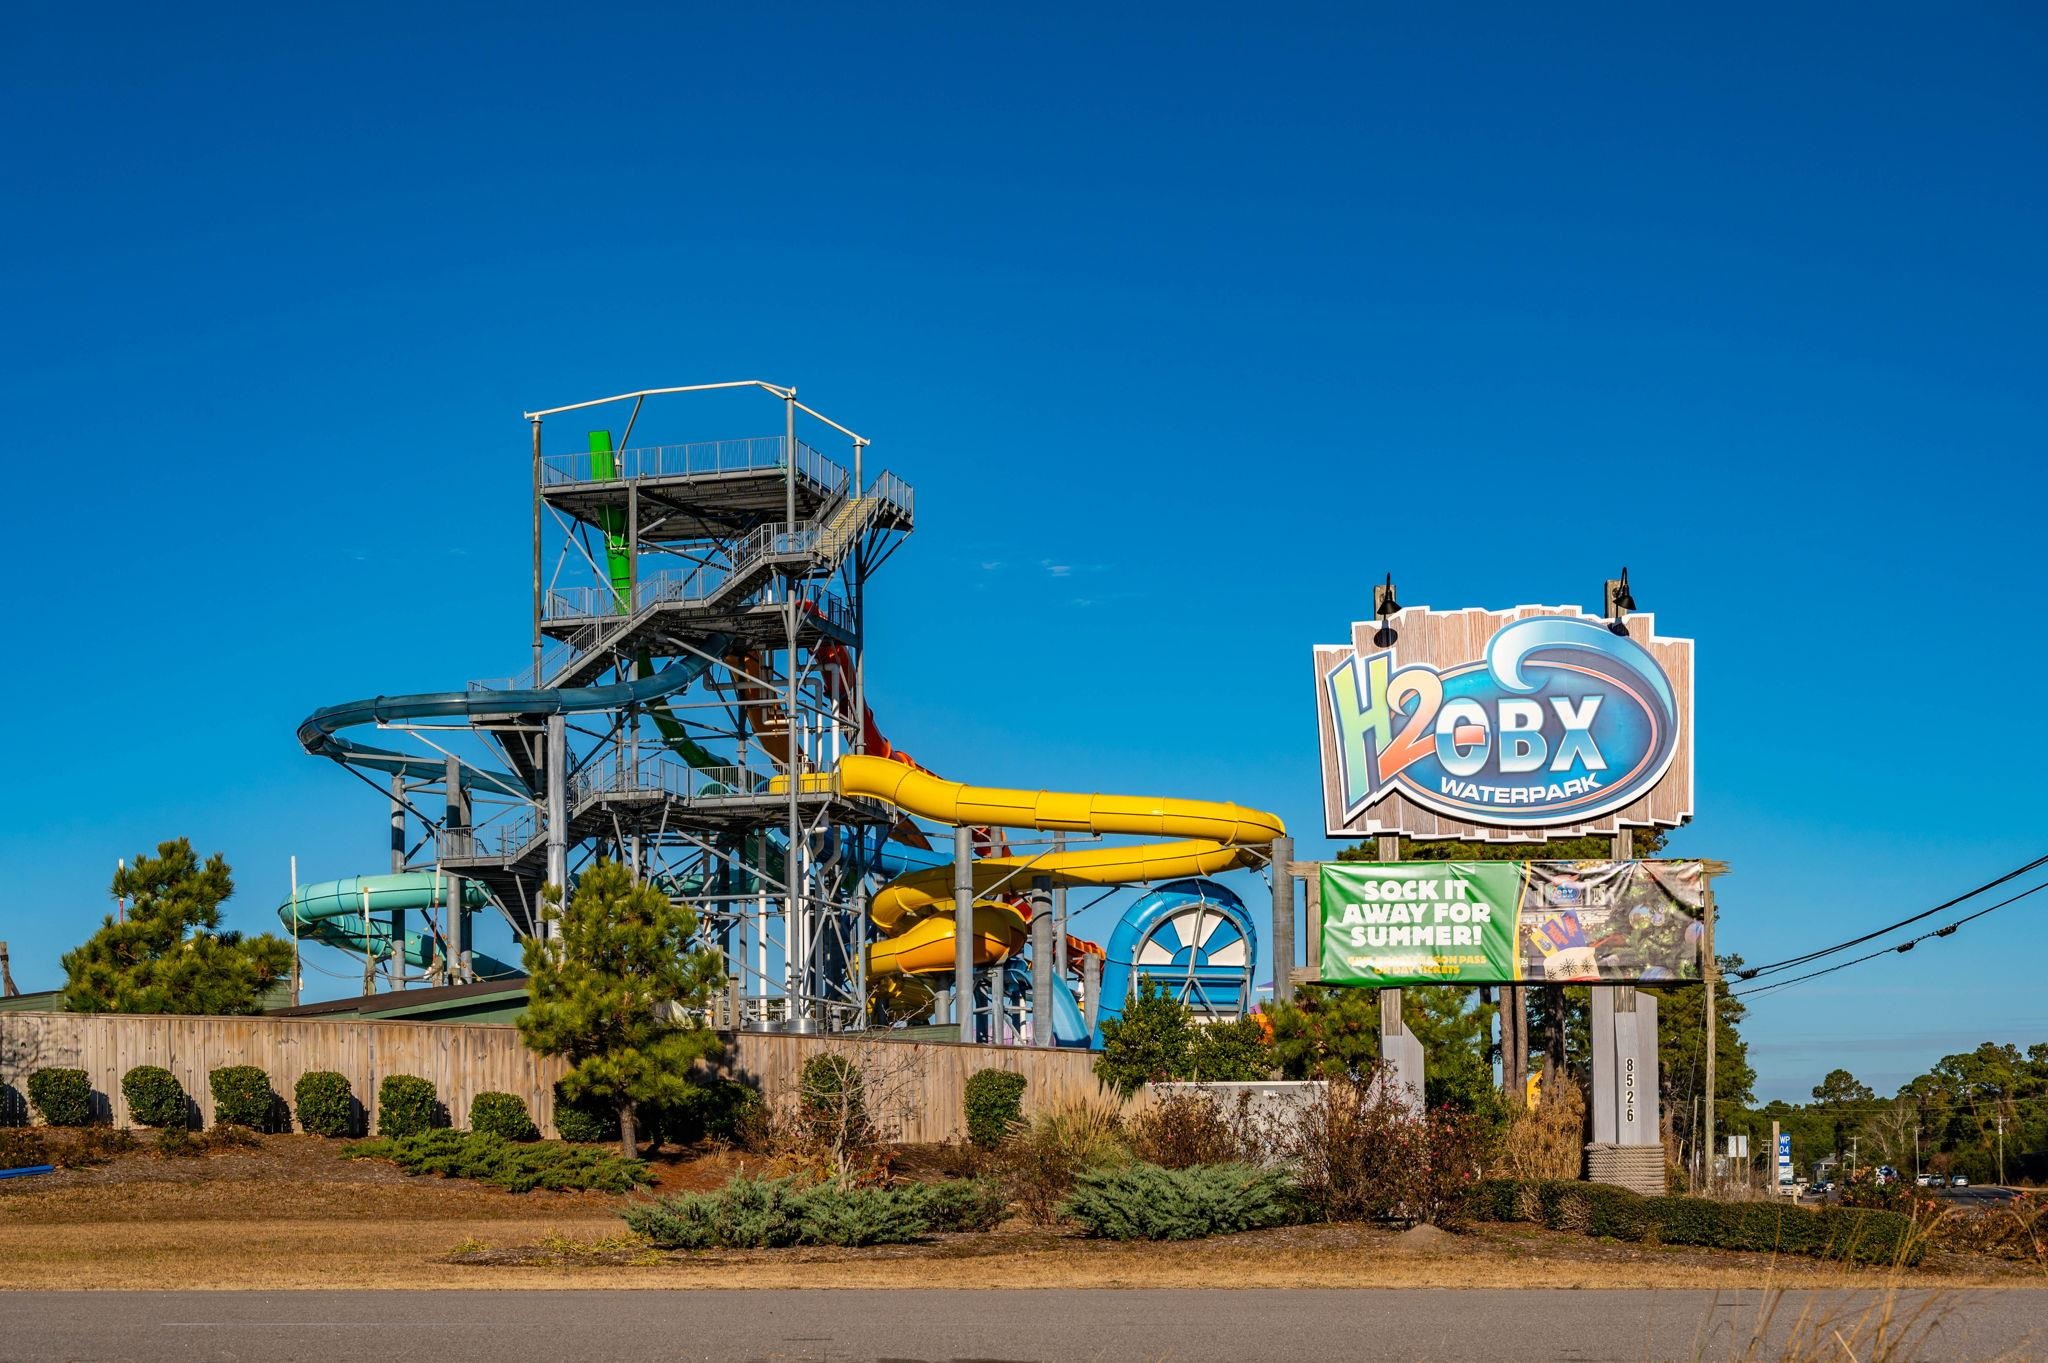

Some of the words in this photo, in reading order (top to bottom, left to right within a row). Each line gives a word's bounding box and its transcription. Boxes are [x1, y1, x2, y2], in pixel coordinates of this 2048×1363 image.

[1440, 773, 1603, 804] WATERPARK
[1364, 880, 1438, 900] SOCK
[1444, 879, 1469, 900] IT
[1343, 903, 1428, 923] AWAY
[1434, 902, 1491, 923] FOR
[1351, 925, 1483, 946] SUMMER!
[1459, 954, 1487, 964] PASS
[1626, 1059, 1634, 1121] 8526
[1780, 1136, 1790, 1144] WP
[1780, 1146, 1788, 1154] 04
